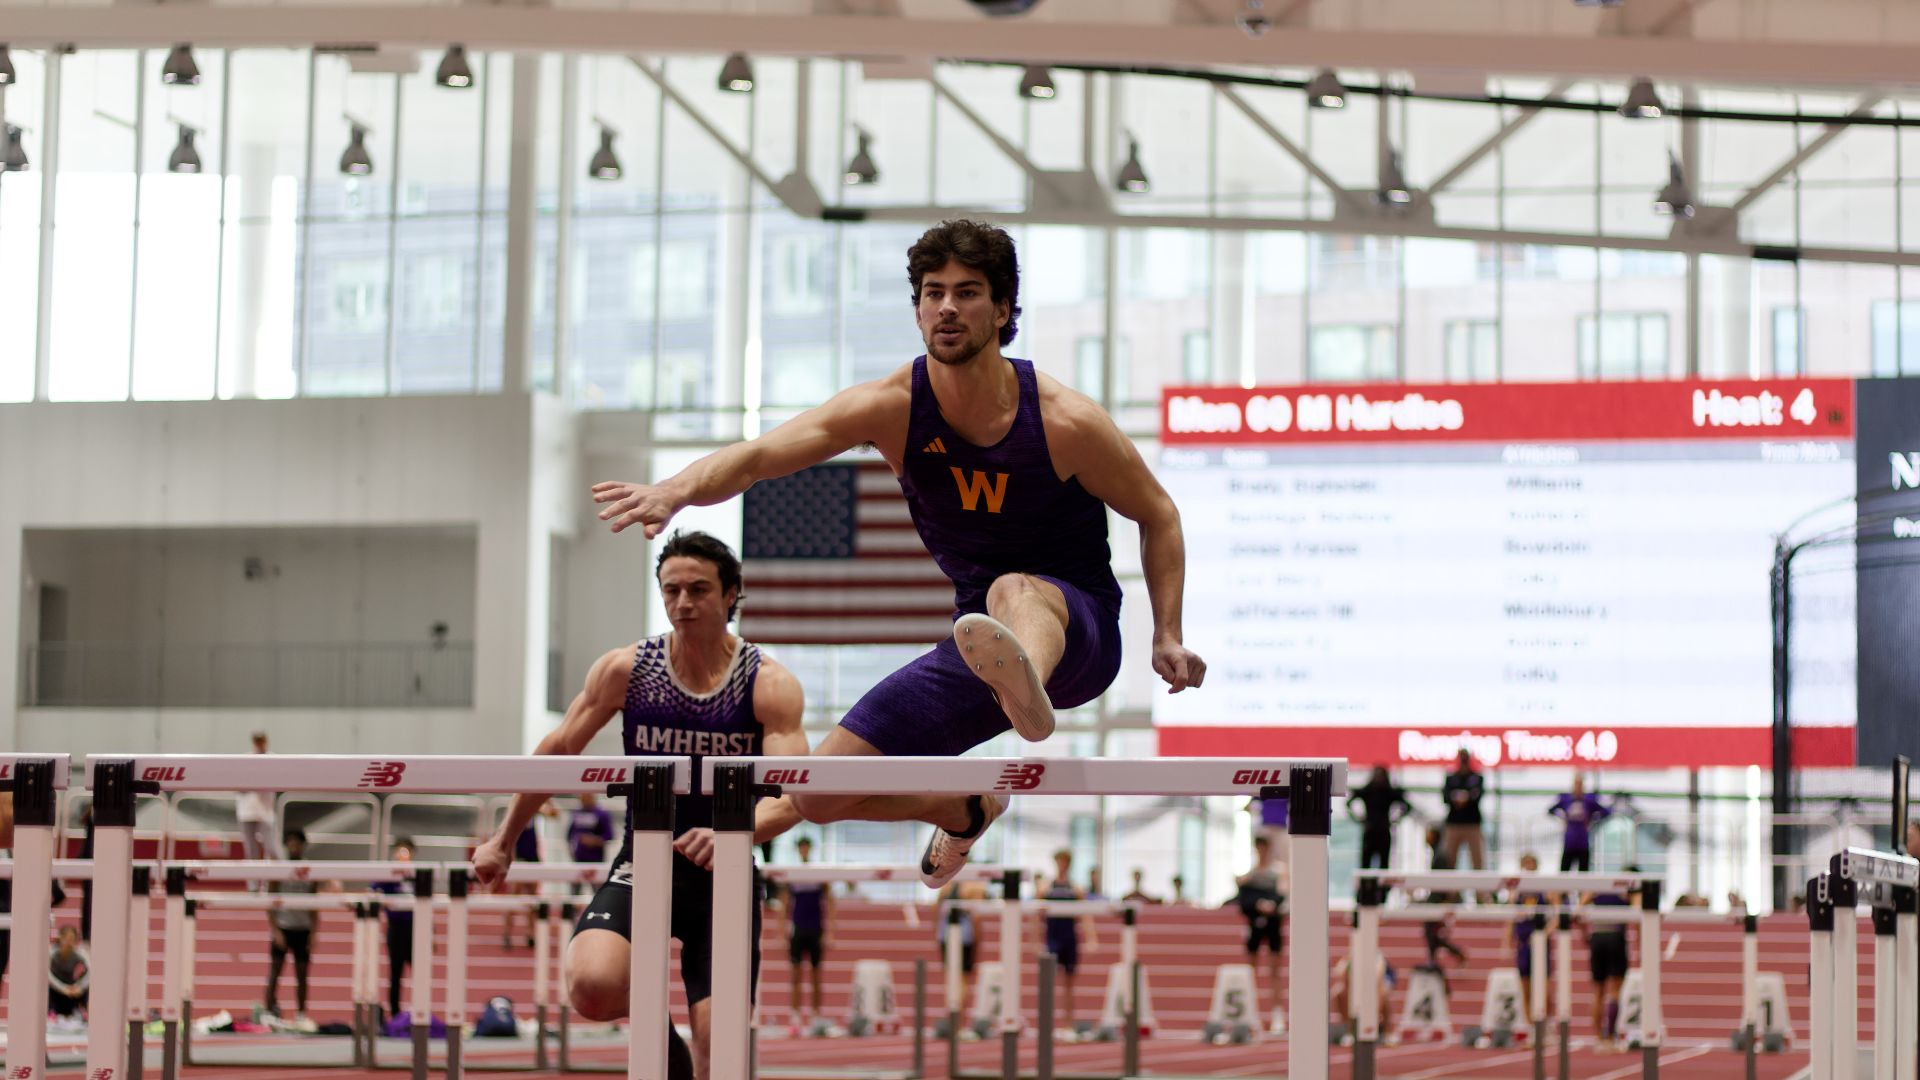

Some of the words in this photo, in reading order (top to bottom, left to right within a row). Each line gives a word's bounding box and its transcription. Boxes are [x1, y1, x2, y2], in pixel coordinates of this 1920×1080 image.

[1168, 395, 1241, 432] Men
[1297, 394, 1333, 432] M
[1336, 393, 1464, 431] Hurdles
[1692, 389, 1783, 426] Heat:
[1790, 388, 1817, 425] 4
[949, 466, 1010, 513] W
[635, 724, 756, 756] AMHERST
[1504, 731, 1573, 761] Time:
[142, 767, 185, 781] GILL
[580, 767, 627, 783] GILL
[763, 769, 810, 784] GILL
[1231, 769, 1282, 785] GILL
[1225, 990, 1246, 1018] 5
[1412, 994, 1434, 1022] 4
